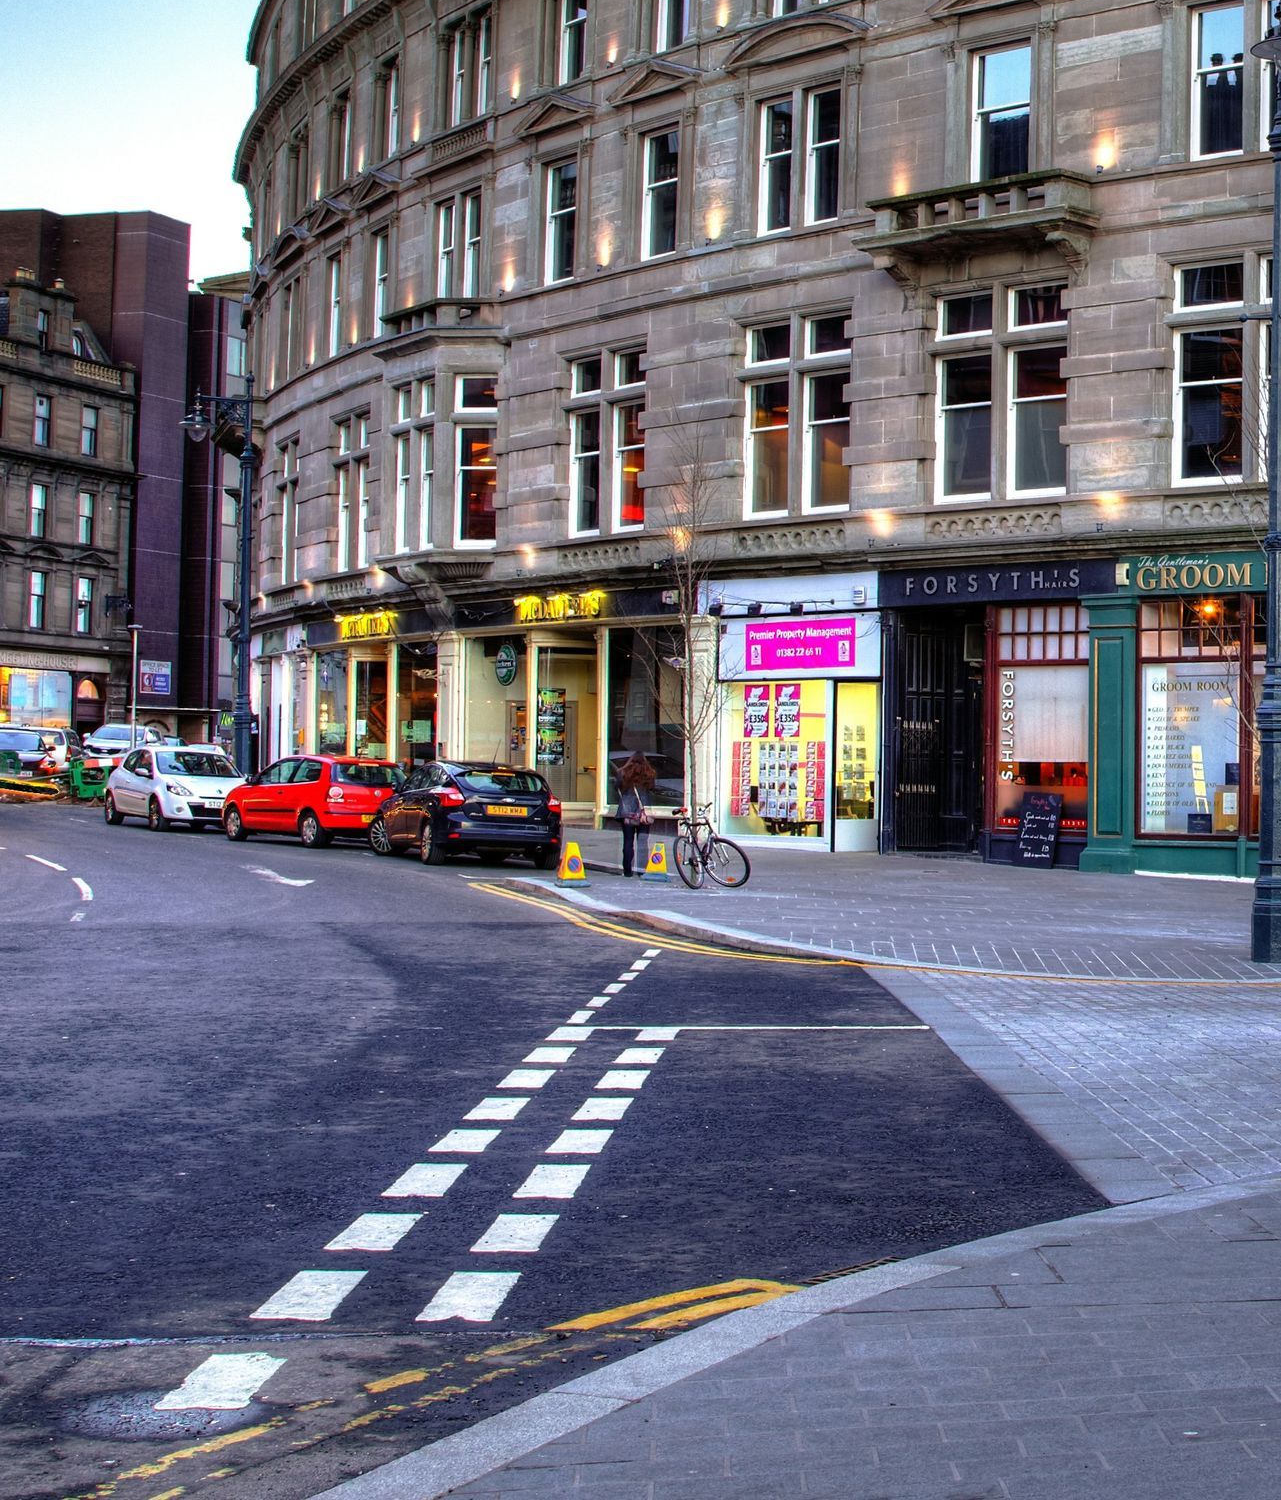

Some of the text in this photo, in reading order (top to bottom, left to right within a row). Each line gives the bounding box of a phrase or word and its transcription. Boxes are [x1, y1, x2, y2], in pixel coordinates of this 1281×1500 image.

[1137, 555, 1210, 567] The Gentleman's
[905, 568, 1080, 596] FORSYTH'S
[1136, 563, 1253, 590] GROOM
[1044, 581, 1068, 589] HAIR
[750, 627, 852, 640] Premier Property Management
[1152, 682, 1192, 692] GROOM
[1001, 671, 1014, 781] FORSYTH'S
